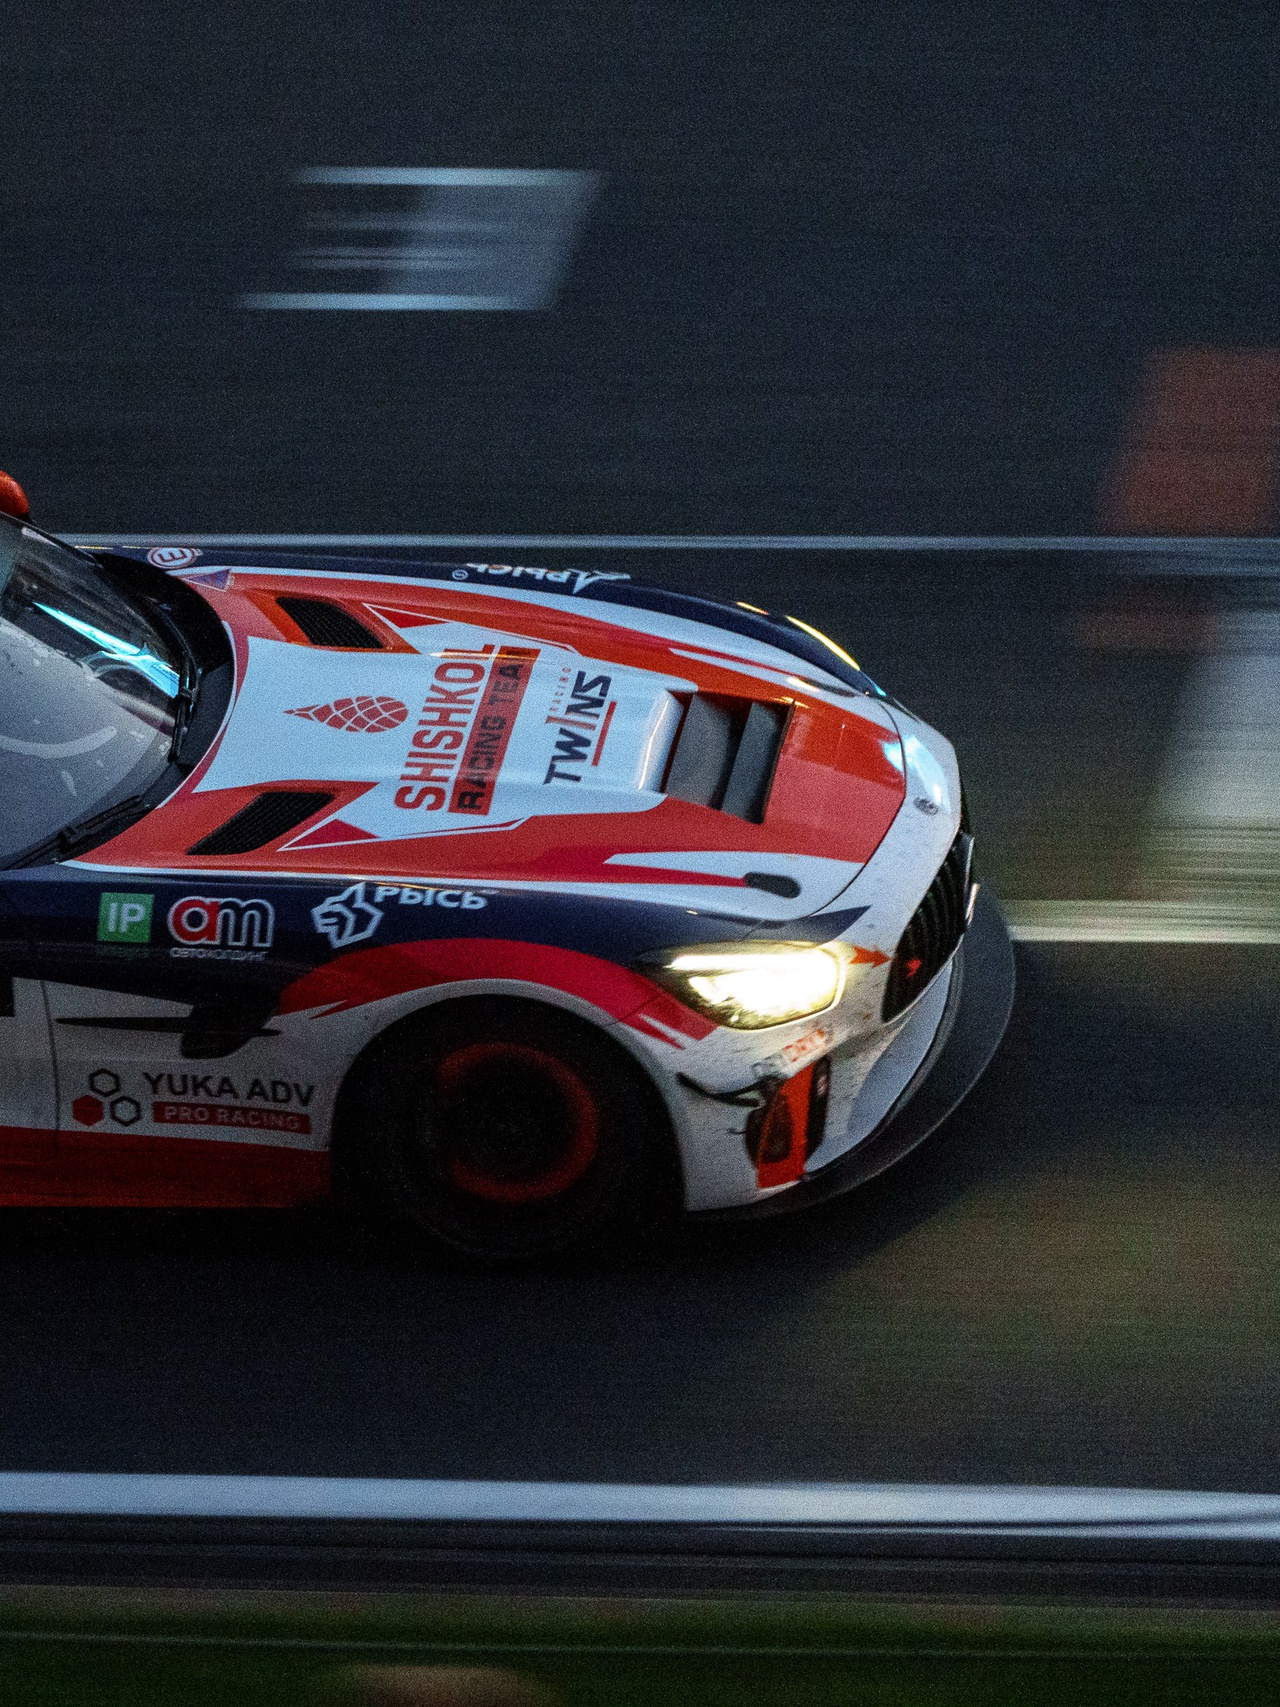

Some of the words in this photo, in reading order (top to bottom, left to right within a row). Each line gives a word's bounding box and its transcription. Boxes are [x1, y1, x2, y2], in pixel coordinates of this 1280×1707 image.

[393, 643, 496, 812] SHISHKOIL
[543, 666, 612, 786] TWINS
[457, 715, 507, 811] RACING
[373, 886, 489, 910] РЫСЬ
[108, 902, 146, 933] IP
[143, 1071, 241, 1100] YUKA
[246, 1078, 315, 1107] ADV
[164, 1105, 210, 1122] PRO
[218, 1109, 302, 1131] RACING
